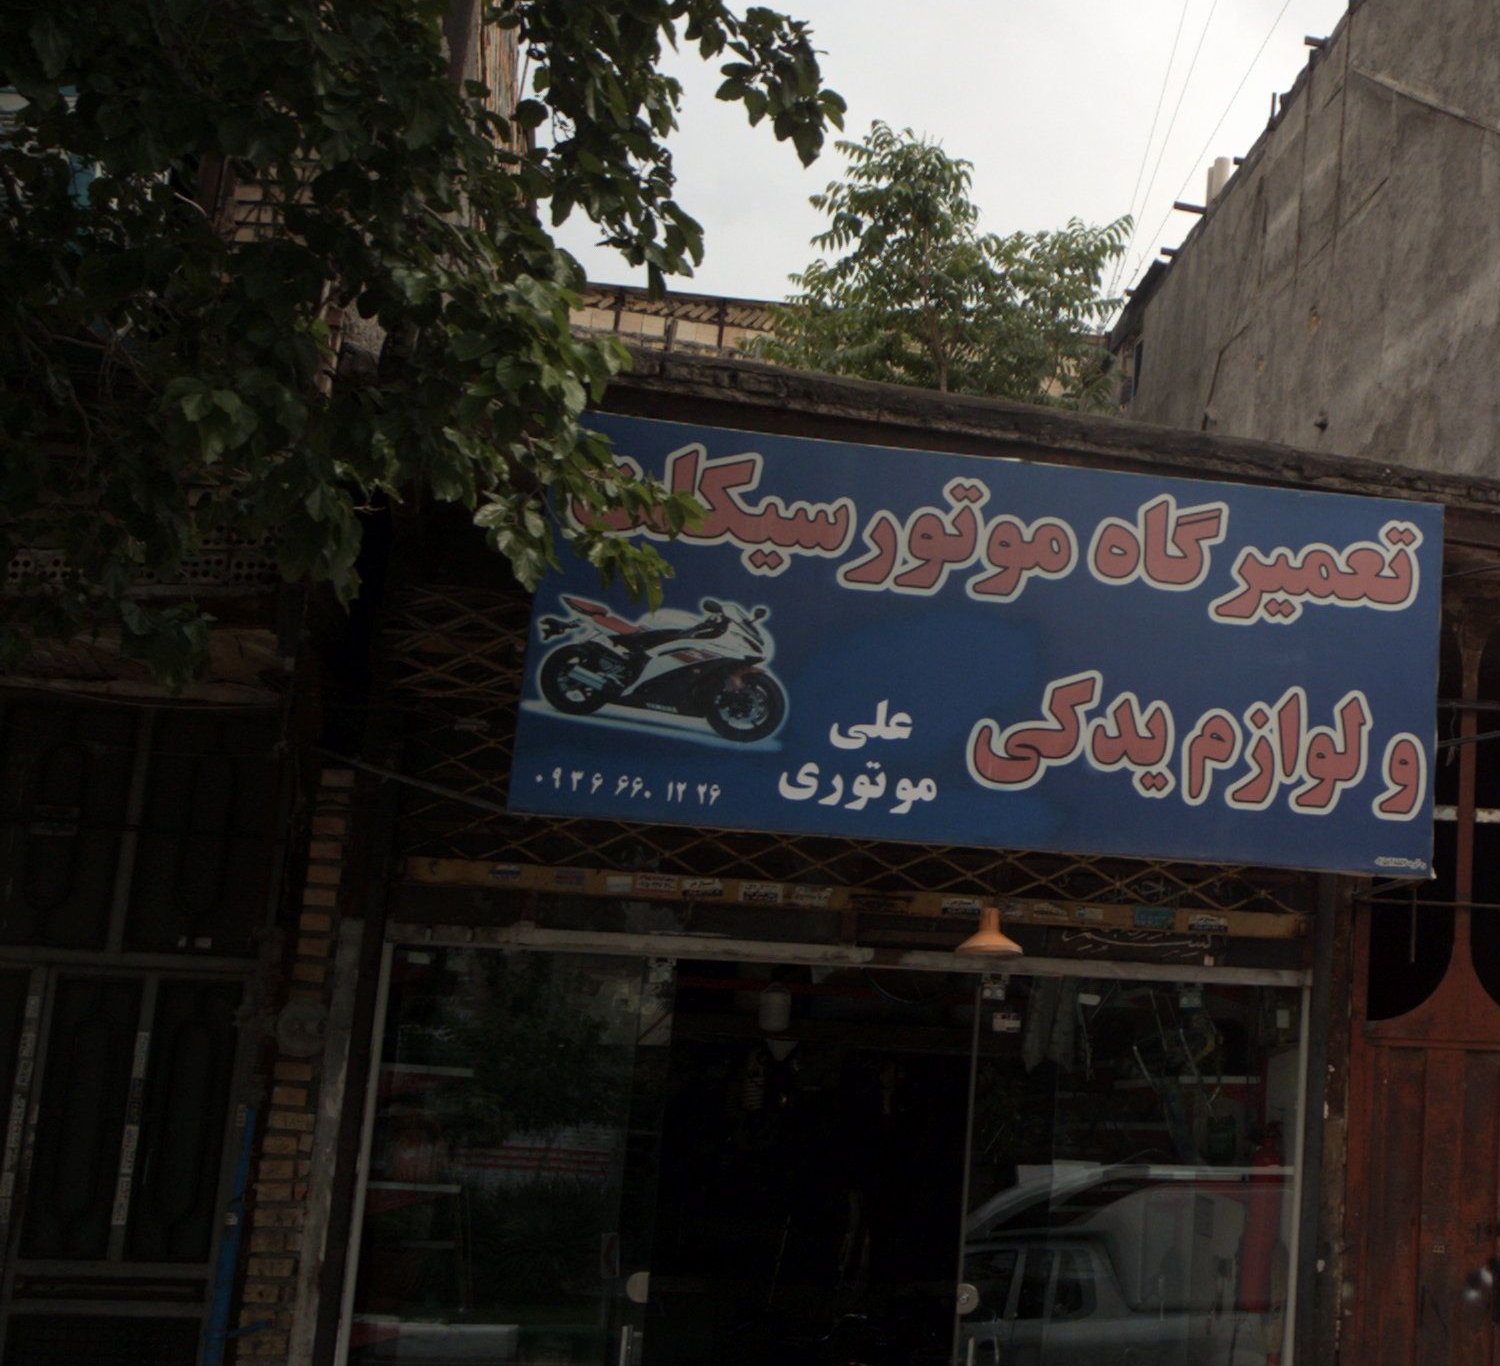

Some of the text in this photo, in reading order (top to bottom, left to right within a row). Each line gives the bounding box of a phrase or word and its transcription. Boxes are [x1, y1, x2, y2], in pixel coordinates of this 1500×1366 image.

[838, 477, 1077, 602] موتور
[829, 698, 913, 751] علی
[966, 668, 1427, 821] و لوازم یدکی
[778, 760, 937, 814] موتوری
